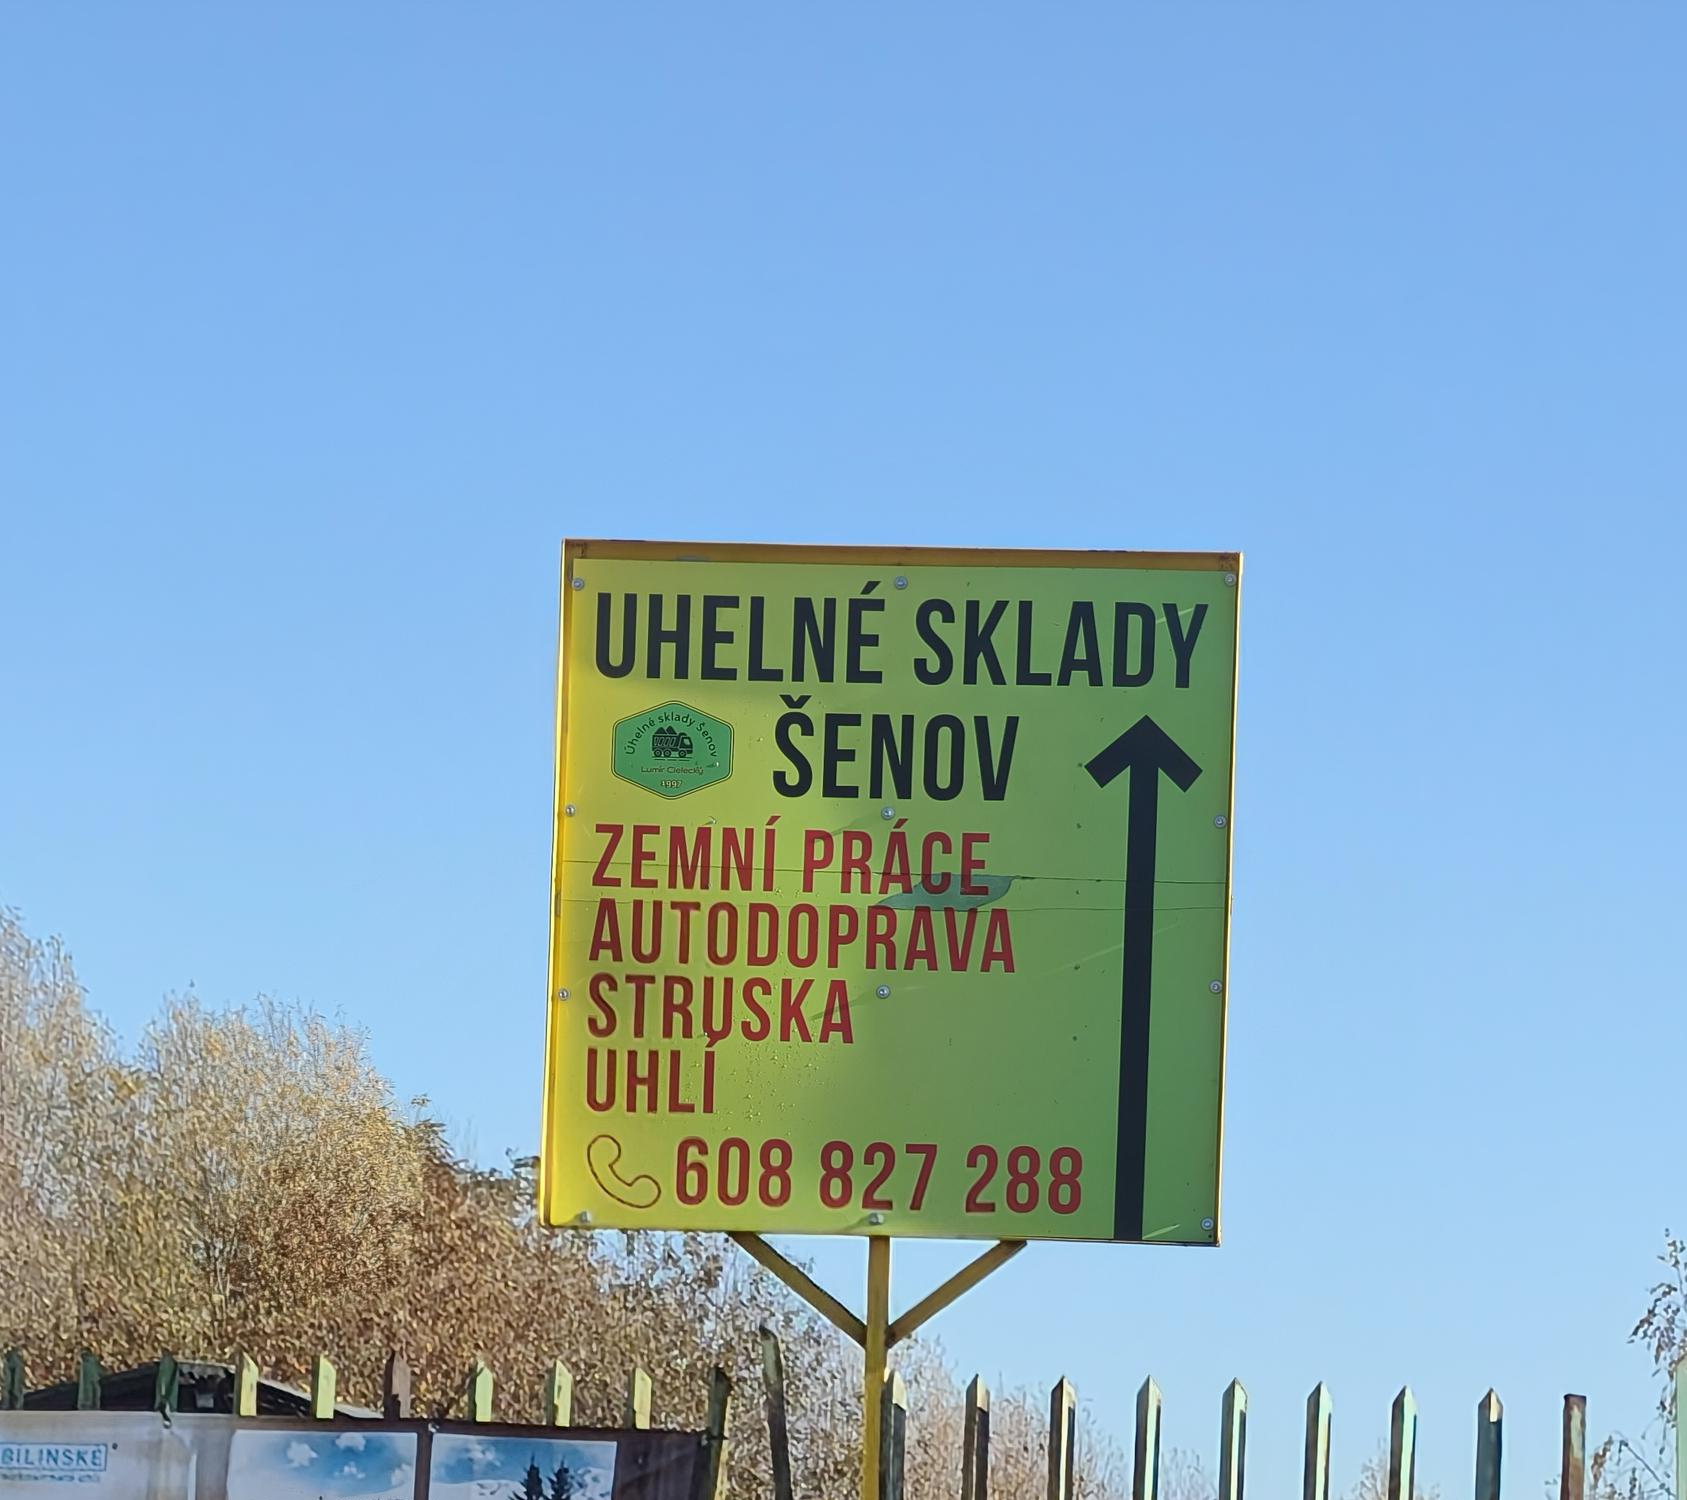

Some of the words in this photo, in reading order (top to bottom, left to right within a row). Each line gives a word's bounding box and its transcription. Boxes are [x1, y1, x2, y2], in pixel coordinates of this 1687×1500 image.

[595, 580, 885, 684] UHELNÉ
[913, 599, 1209, 689] SKLADY
[658, 711, 696, 727] sklady
[696, 721, 718, 758] Šenov
[773, 694, 1020, 801] ŠENOV
[591, 815, 779, 892] ZEMNÍ
[802, 818, 991, 896] PRÁCE
[588, 897, 1016, 973] AUTODOPRAVA
[586, 973, 855, 1044] STRUSKA
[585, 1033, 717, 1114] UHLÍ
[674, 1136, 793, 1207] 608
[819, 1140, 938, 1211] 827
[965, 1145, 1083, 1214] 288
